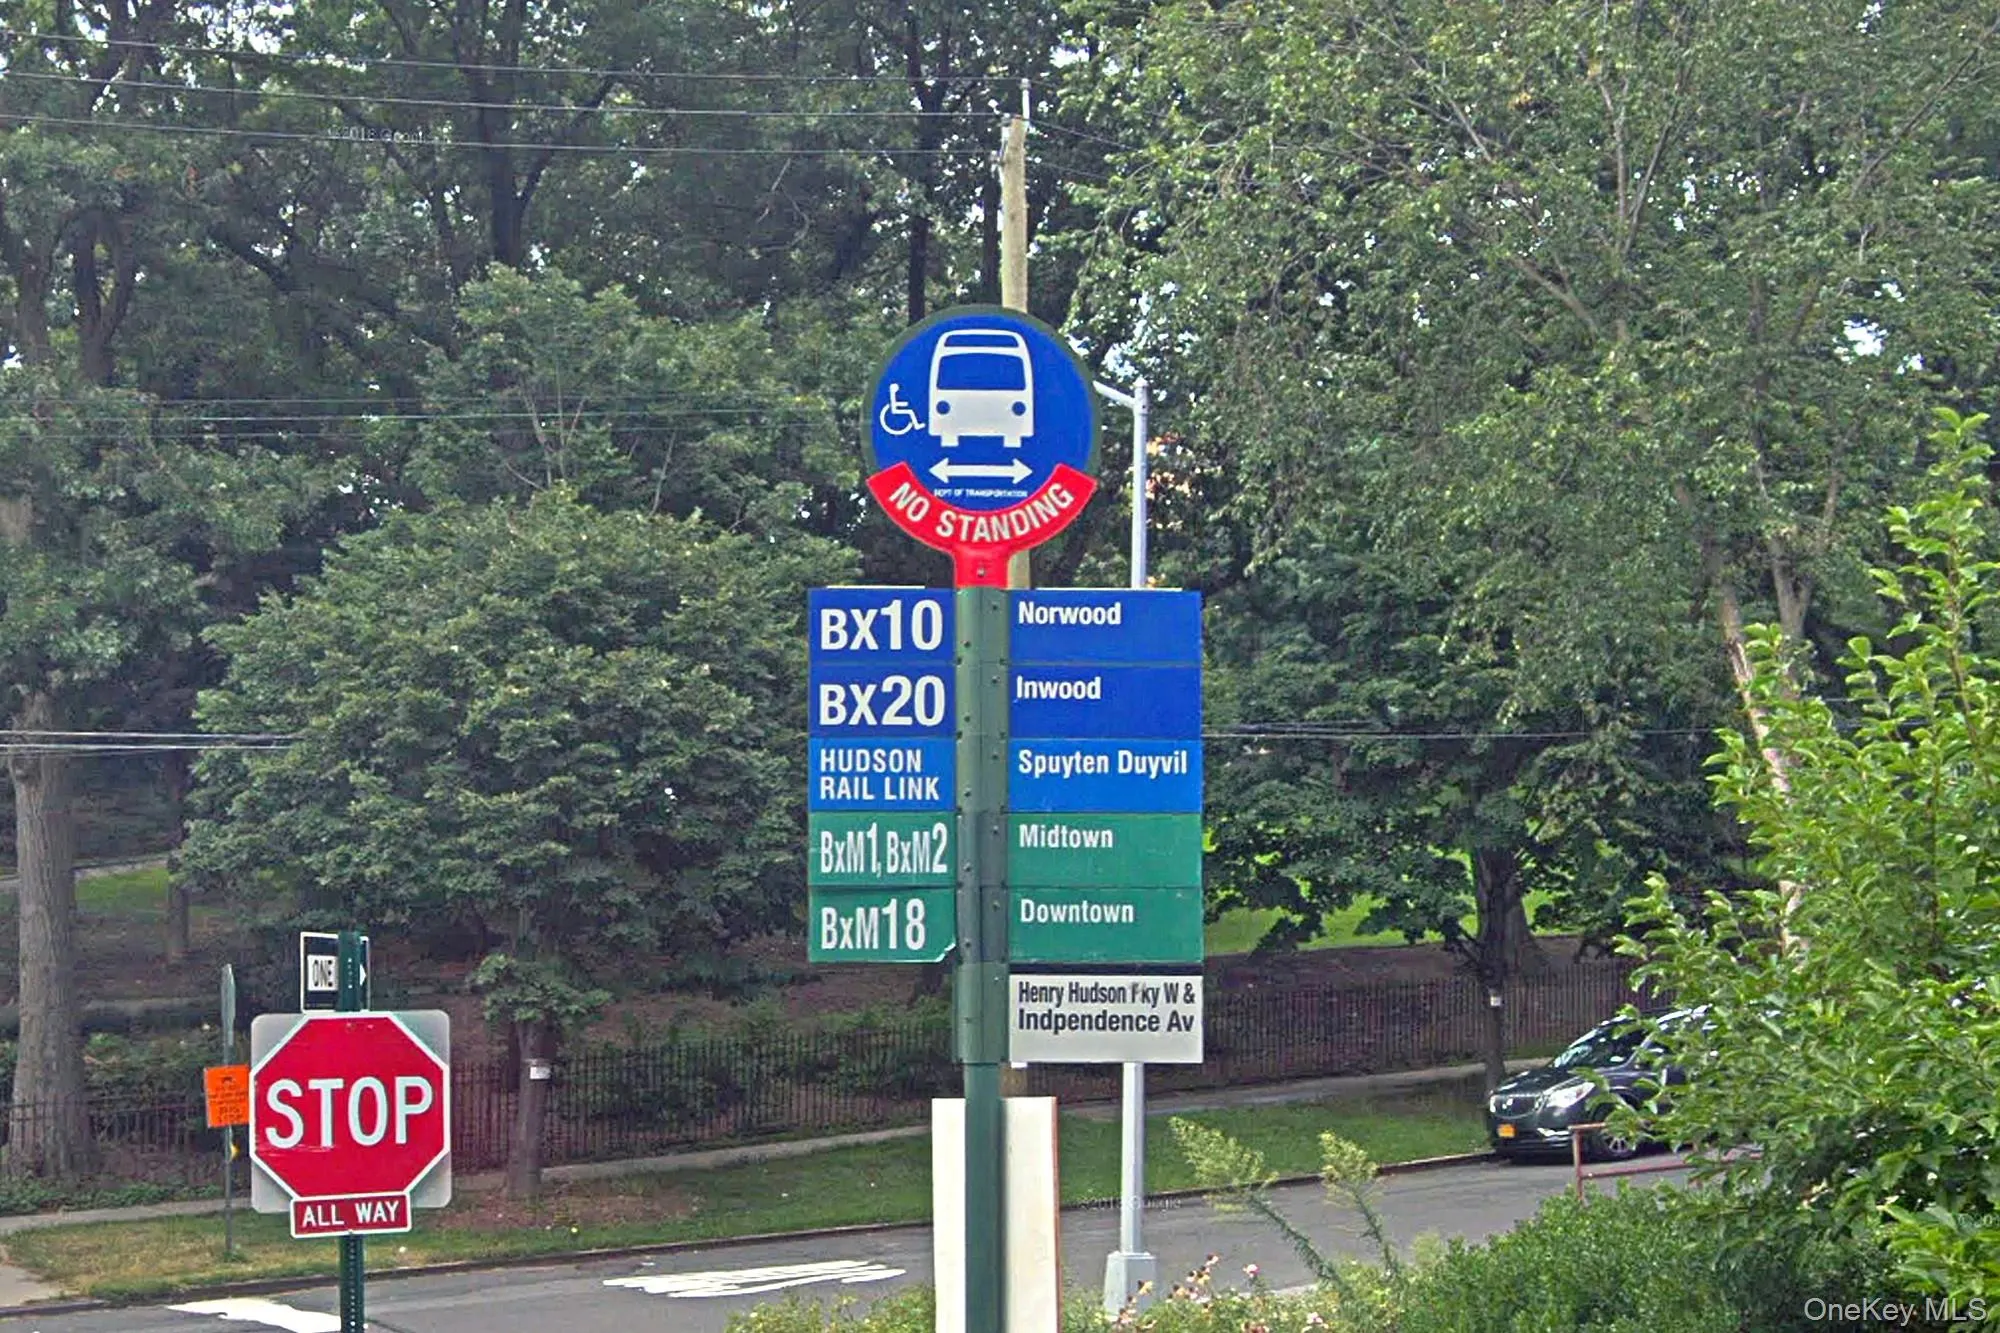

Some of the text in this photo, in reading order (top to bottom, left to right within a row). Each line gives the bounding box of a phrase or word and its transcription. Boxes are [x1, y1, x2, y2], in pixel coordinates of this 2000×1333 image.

[889, 482, 1075, 543] NO STANDING
[820, 599, 944, 651] BX10
[1018, 601, 1122, 625] Norwood
[818, 675, 945, 727] BX20
[1016, 676, 1102, 700] Inwood
[820, 748, 922, 773] HUDSON
[1018, 749, 1188, 779] Spuyten Duyvil
[820, 776, 939, 801] RAIL LINK
[1019, 824, 1113, 848] Midtown
[821, 898, 926, 951] BxM18
[1020, 899, 1134, 923] Downtown
[312, 959, 335, 987] ONE
[1018, 981, 1063, 1007] Henry
[1068, 981, 1126, 1004] Hudson
[1163, 982, 1179, 1004] W
[1183, 982, 1196, 1005] &
[1018, 1009, 1194, 1034] Indpendence Av
[264, 1075, 433, 1149] STOP
[302, 1200, 400, 1228] ALL WAY
